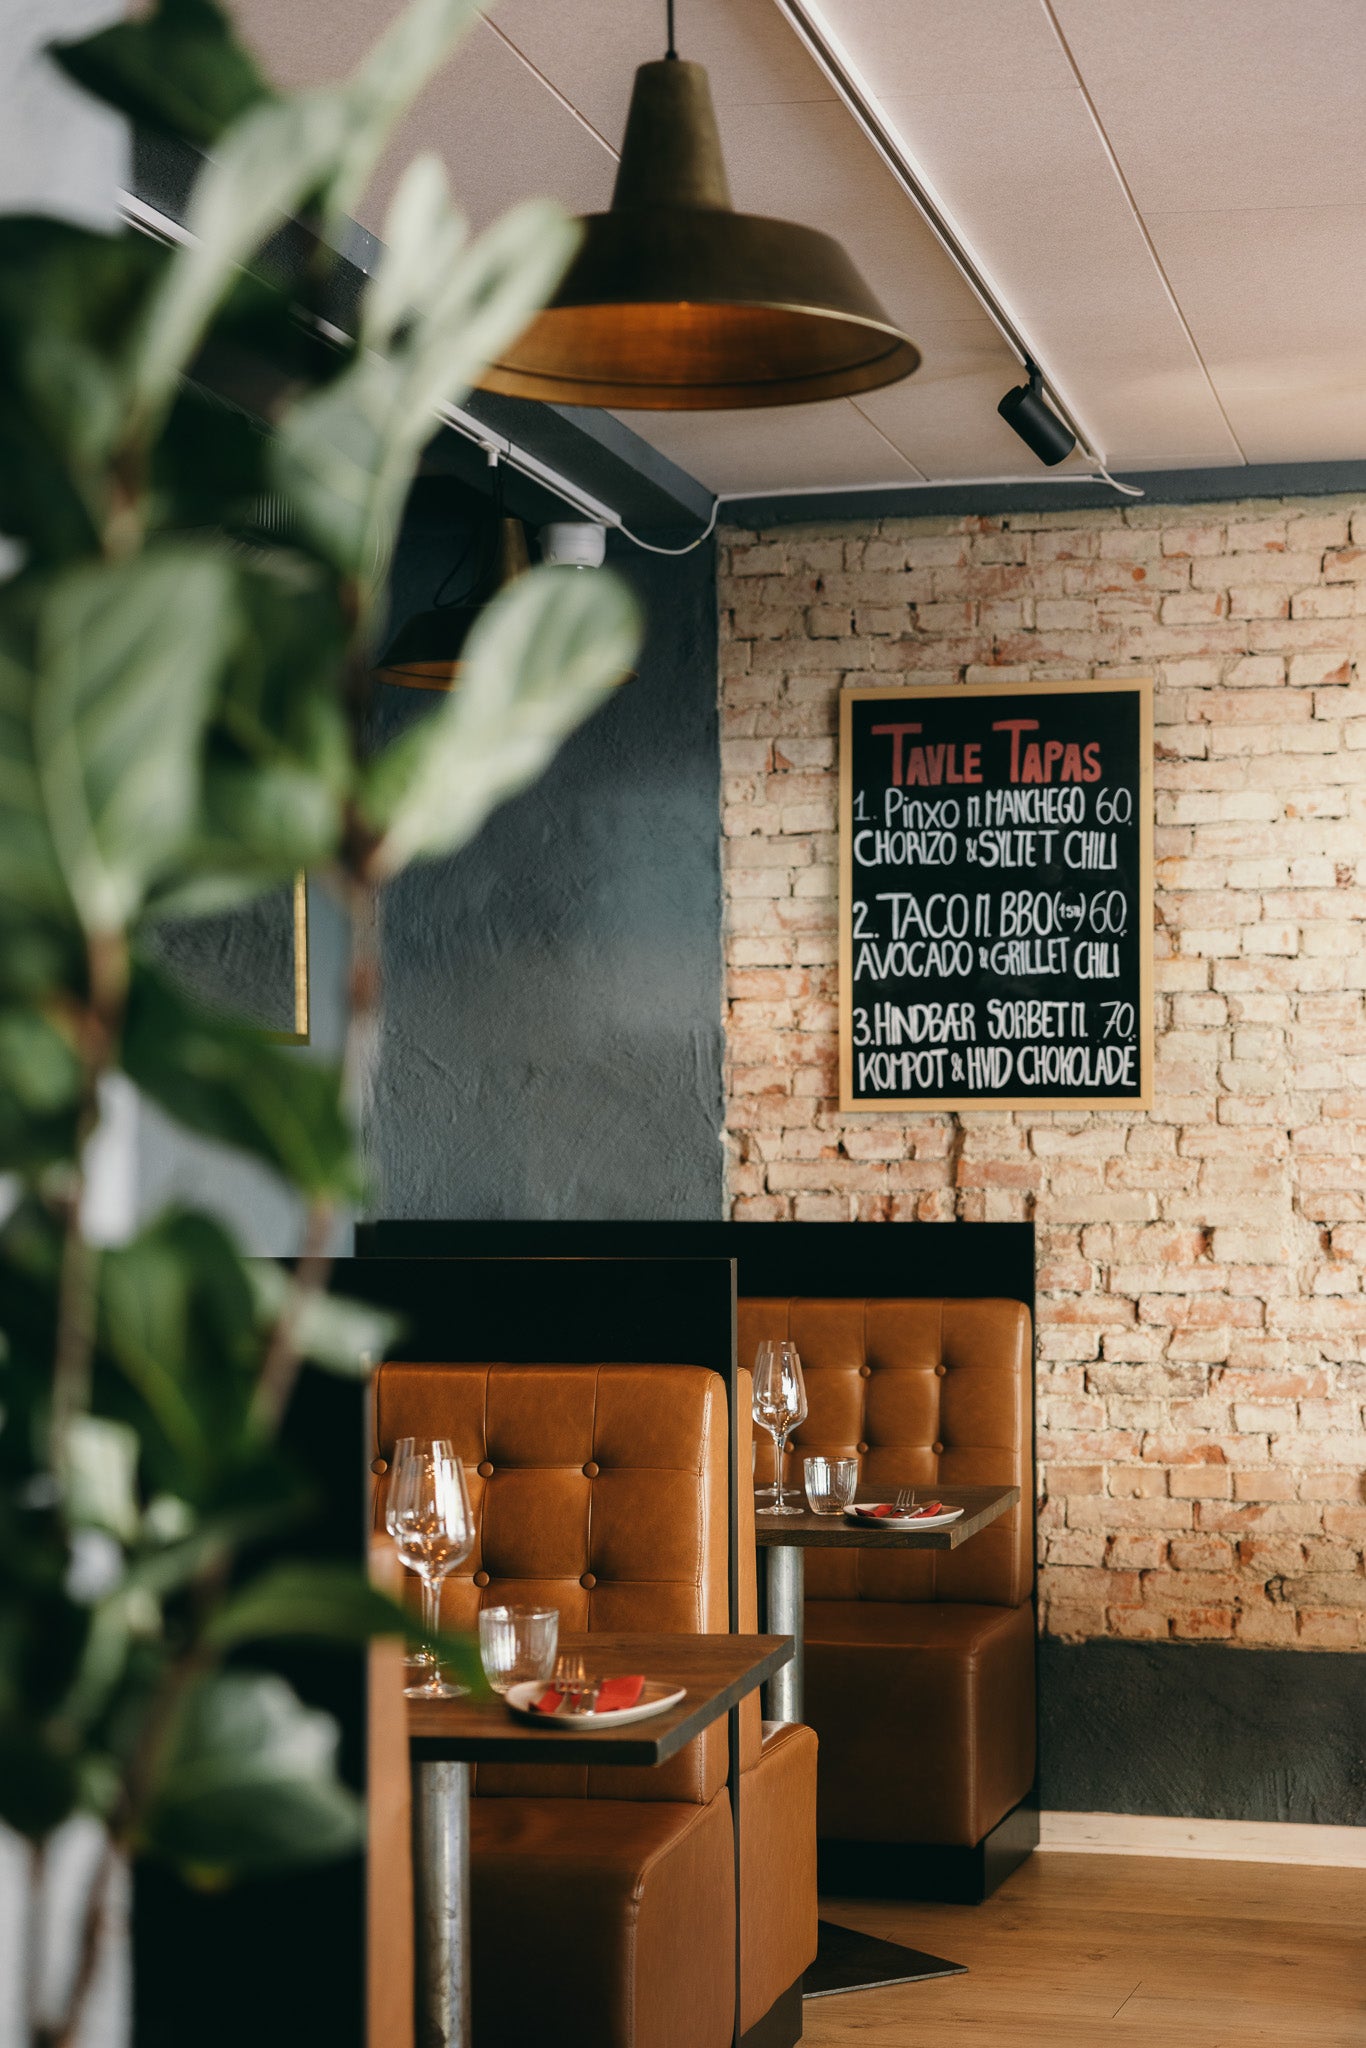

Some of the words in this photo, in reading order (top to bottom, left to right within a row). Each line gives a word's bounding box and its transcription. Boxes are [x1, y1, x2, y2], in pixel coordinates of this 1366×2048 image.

[871, 723, 983, 786] TAVLE
[992, 719, 1102, 783] TAPAS
[853, 790, 877, 820] 1.
[985, 787, 1085, 827] MANCHEGO
[854, 829, 956, 866] CHORIZO
[979, 829, 1060, 868] SYLTET
[1064, 830, 1117, 869] CHILI
[852, 901, 879, 939] 2.
[876, 892, 969, 940] TACO
[854, 940, 973, 978] AVOCADO
[990, 936, 1070, 976] GRILLET
[1074, 941, 1120, 979] CHILI
[987, 999, 1070, 1040] SORBET
[858, 1048, 949, 1092] KOMPOT
[951, 1052, 965, 1082] &
[966, 1046, 1013, 1090] HVID
[1017, 1045, 1138, 1087] CHOKOLADE
